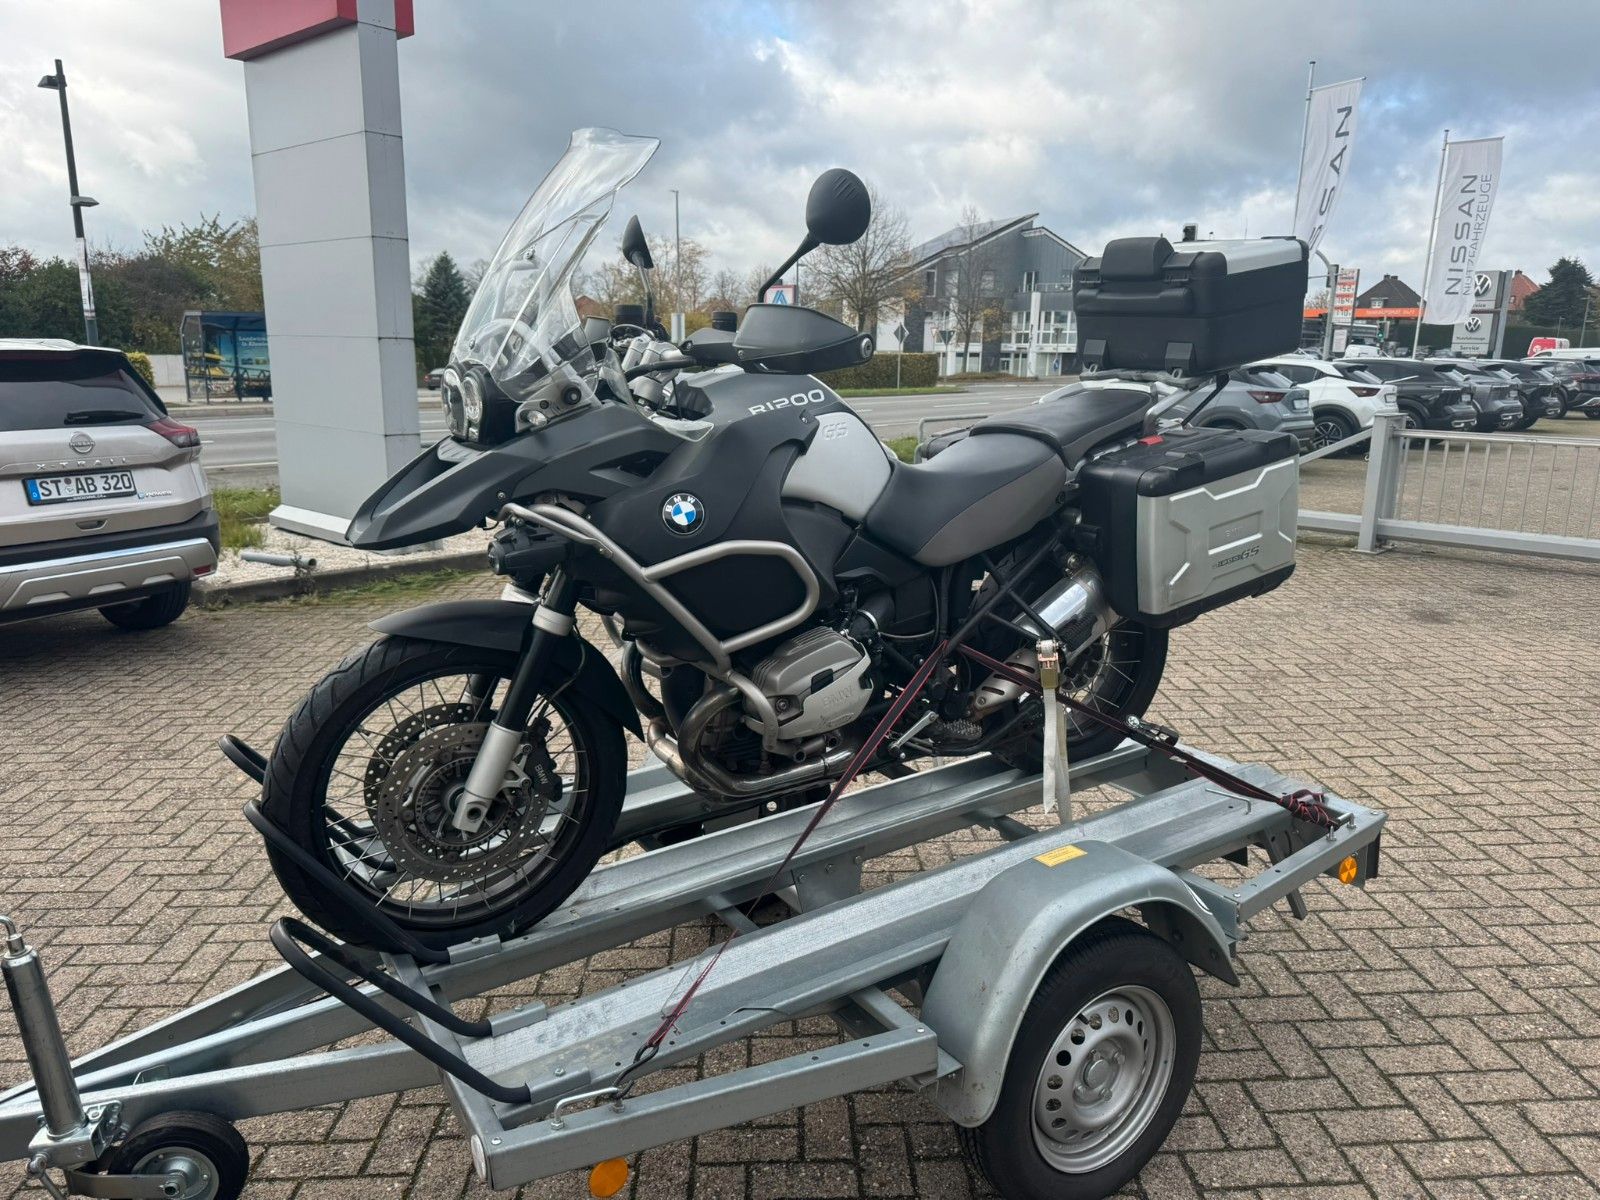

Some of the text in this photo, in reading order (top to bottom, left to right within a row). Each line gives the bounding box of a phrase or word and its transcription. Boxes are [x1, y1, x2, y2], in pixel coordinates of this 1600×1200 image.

[1445, 174, 1478, 295] NISSAN
[748, 389, 825, 415] R1200
[823, 422, 849, 440] GS
[39, 473, 132, 497] ST AB 320
[665, 495, 695, 512] BMW
[534, 764, 549, 785] BMW
